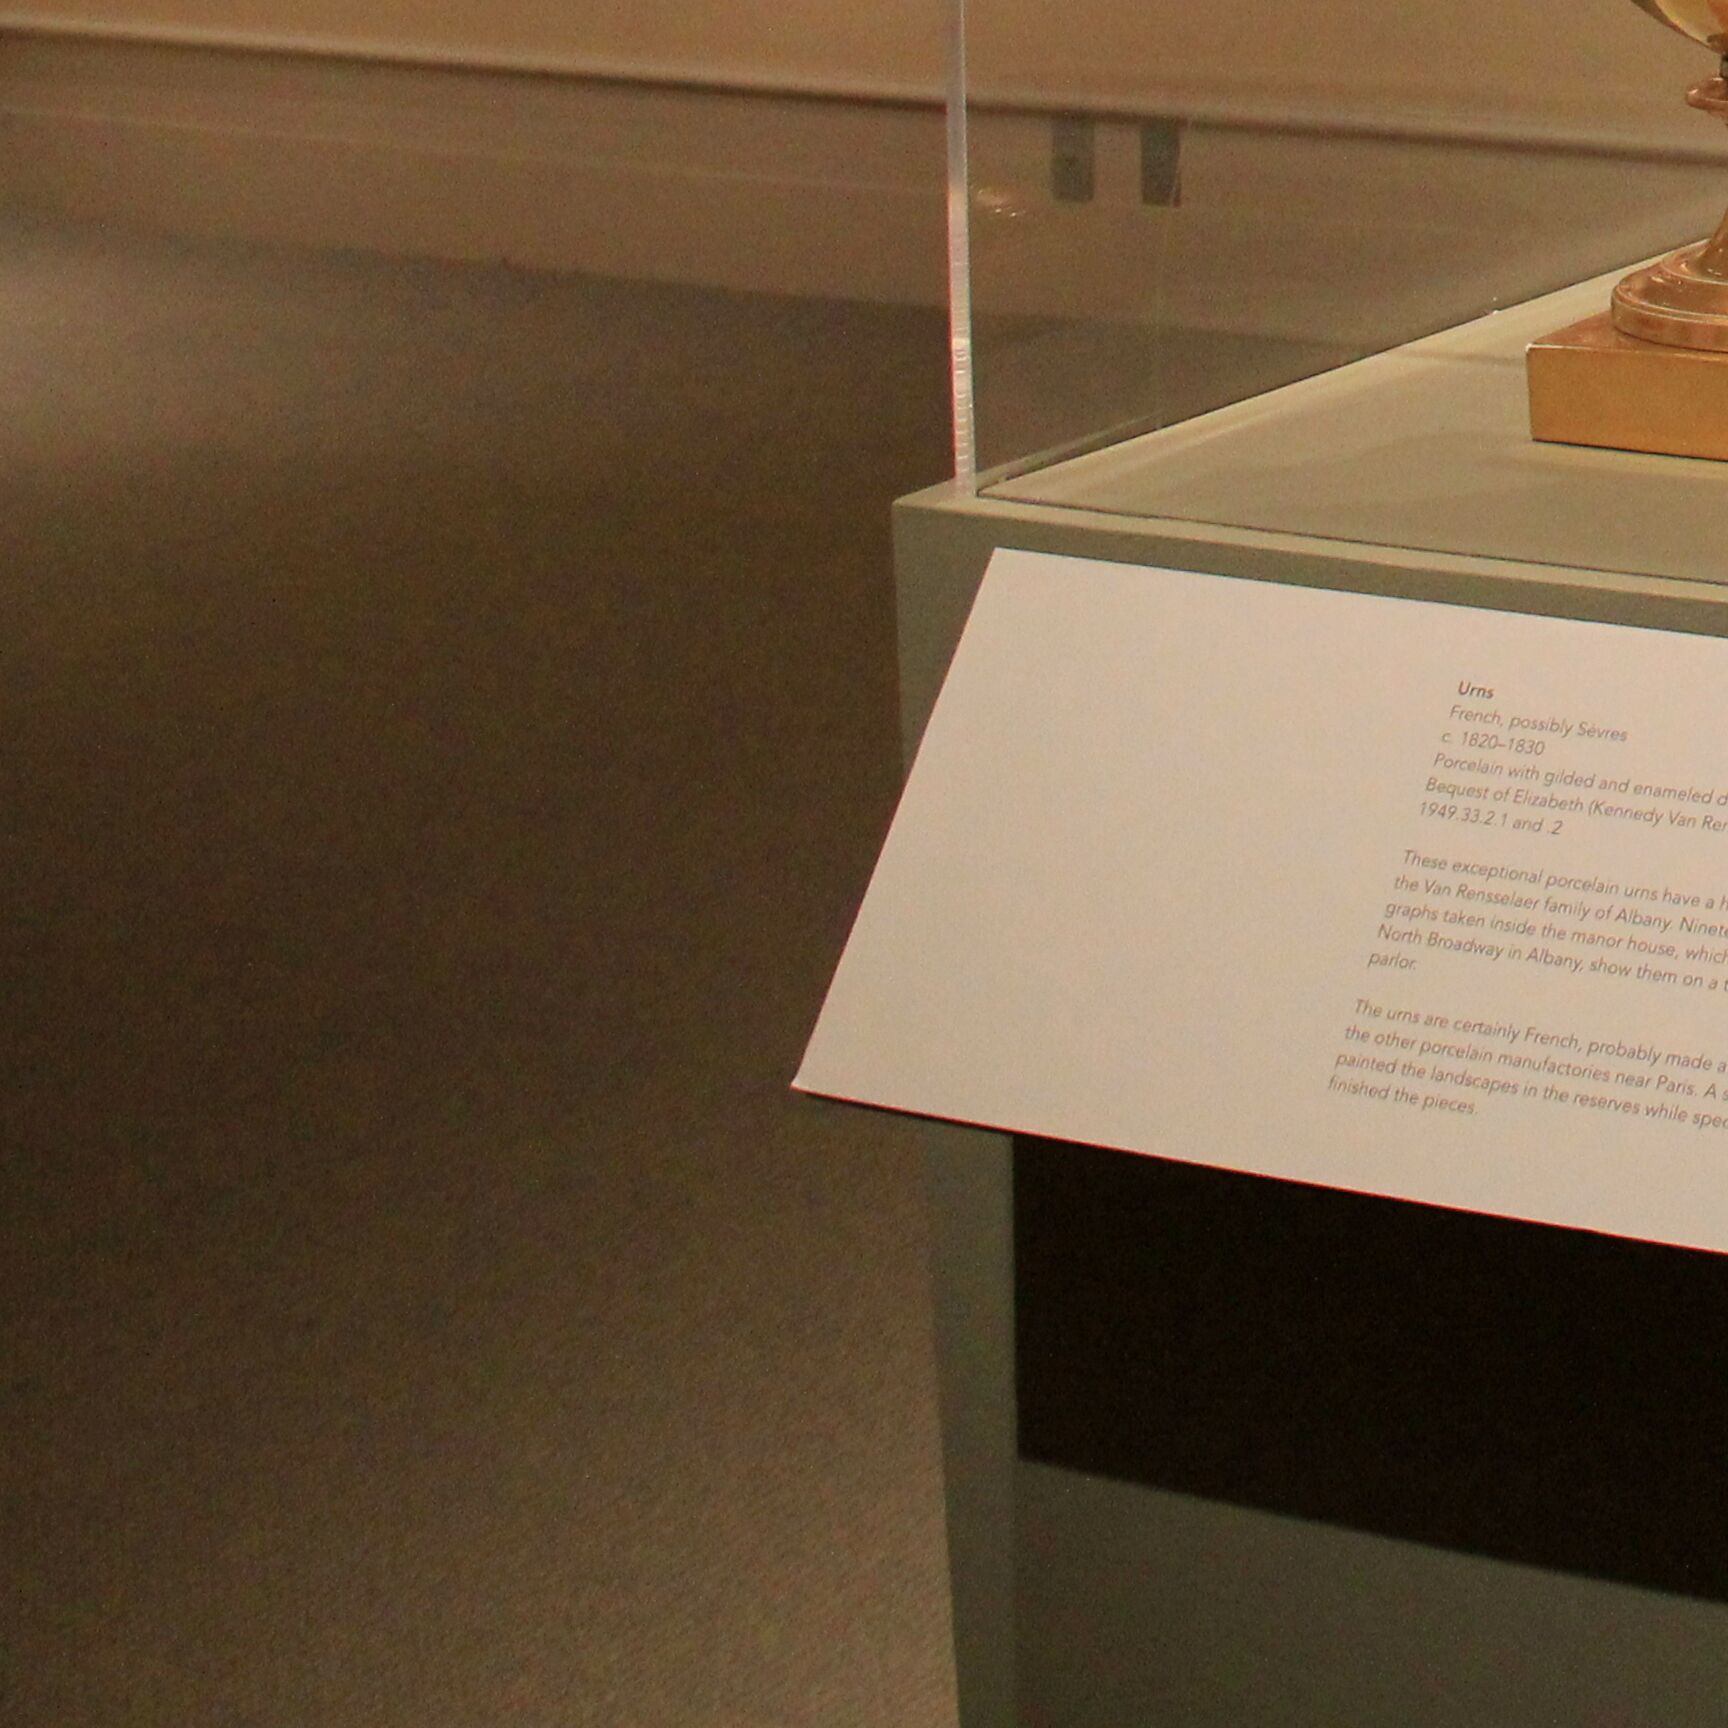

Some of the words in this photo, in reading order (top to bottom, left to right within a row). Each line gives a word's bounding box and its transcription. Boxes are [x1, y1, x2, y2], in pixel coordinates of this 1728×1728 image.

[1458, 681, 1495, 700] Urns
[1450, 705, 1504, 728] French,
[1508, 717, 1574, 739] possibly
[1426, 776, 1490, 801] Bequest
[1493, 787, 1512, 802] of
[1513, 789, 1584, 812] Elizabeth
[1589, 800, 1664, 828] (Kennedy
[1670, 811, 1697, 828] Van
[1434, 753, 1504, 776] Porcelain
[1509, 765, 1540, 781] with
[1543, 770, 1597, 789] gilded
[1598, 779, 1631, 794] and
[1634, 785, 1715, 805] enameled
[1513, 818, 1545, 833] and
[1394, 875, 1419, 893] the
[1425, 879, 1452, 897] Van
[1456, 884, 1541, 911] Rensselaer
[1544, 896, 1591, 922] family
[1595, 905, 1614, 921] of
[1614, 908, 1673, 934] Albany.
[1405, 850, 1448, 871] These
[1452, 862, 1544, 885] exceptional
[1544, 875, 1620, 896] porcelain
[1624, 887, 1659, 902] urns
[1663, 887, 1701, 907] have
[1706, 898, 1715, 910] a
[1378, 924, 1423, 945] North
[1426, 931, 1505, 962] Broadway
[1508, 944, 1522, 960] in
[1526, 948, 1584, 974] Albany,
[1590, 957, 1632, 977] show
[1637, 963, 1678, 985] them
[1683, 976, 1703, 988] on
[1708, 979, 1718, 991] a
[1384, 904, 1439, 923] graphs
[1443, 910, 1485, 928] taken
[1491, 915, 1537, 937] inside
[1542, 923, 1567, 941] the
[1571, 931, 1625, 949] manor
[1627, 934, 1679, 960] house,
[1367, 952, 1417, 970] parlor.
[1356, 999, 1383, 1019] The
[1386, 1010, 1421, 1025] urns
[1424, 1015, 1450, 1030] are
[1453, 1020, 1521, 1045] certainly
[1524, 1027, 1582, 1053] French,
[1587, 1040, 1662, 1068] probably
[1664, 1053, 1713, 1071] made
[1335, 1054, 1399, 1075] painted
[1401, 1061, 1427, 1080] the
[1430, 1065, 1520, 1096] landscapes
[1523, 1081, 1538, 1098] in
[1543, 1085, 1569, 1103] the
[1573, 1094, 1641, 1115] reserves
[1646, 1102, 1688, 1123] while
[1346, 1025, 1371, 1044] the
[1374, 1031, 1418, 1051] other
[1418, 1041, 1493, 1063] porcelain
[1498, 1054, 1611, 1083] manufactories
[1615, 1073, 1653, 1089] near
[1656, 1075, 1698, 1097] Paris.
[1703, 1083, 1717, 1100] A
[1328, 1074, 1392, 1101] finished
[1394, 1087, 1420, 1106] the
[1422, 1095, 1478, 1115] pieces.
